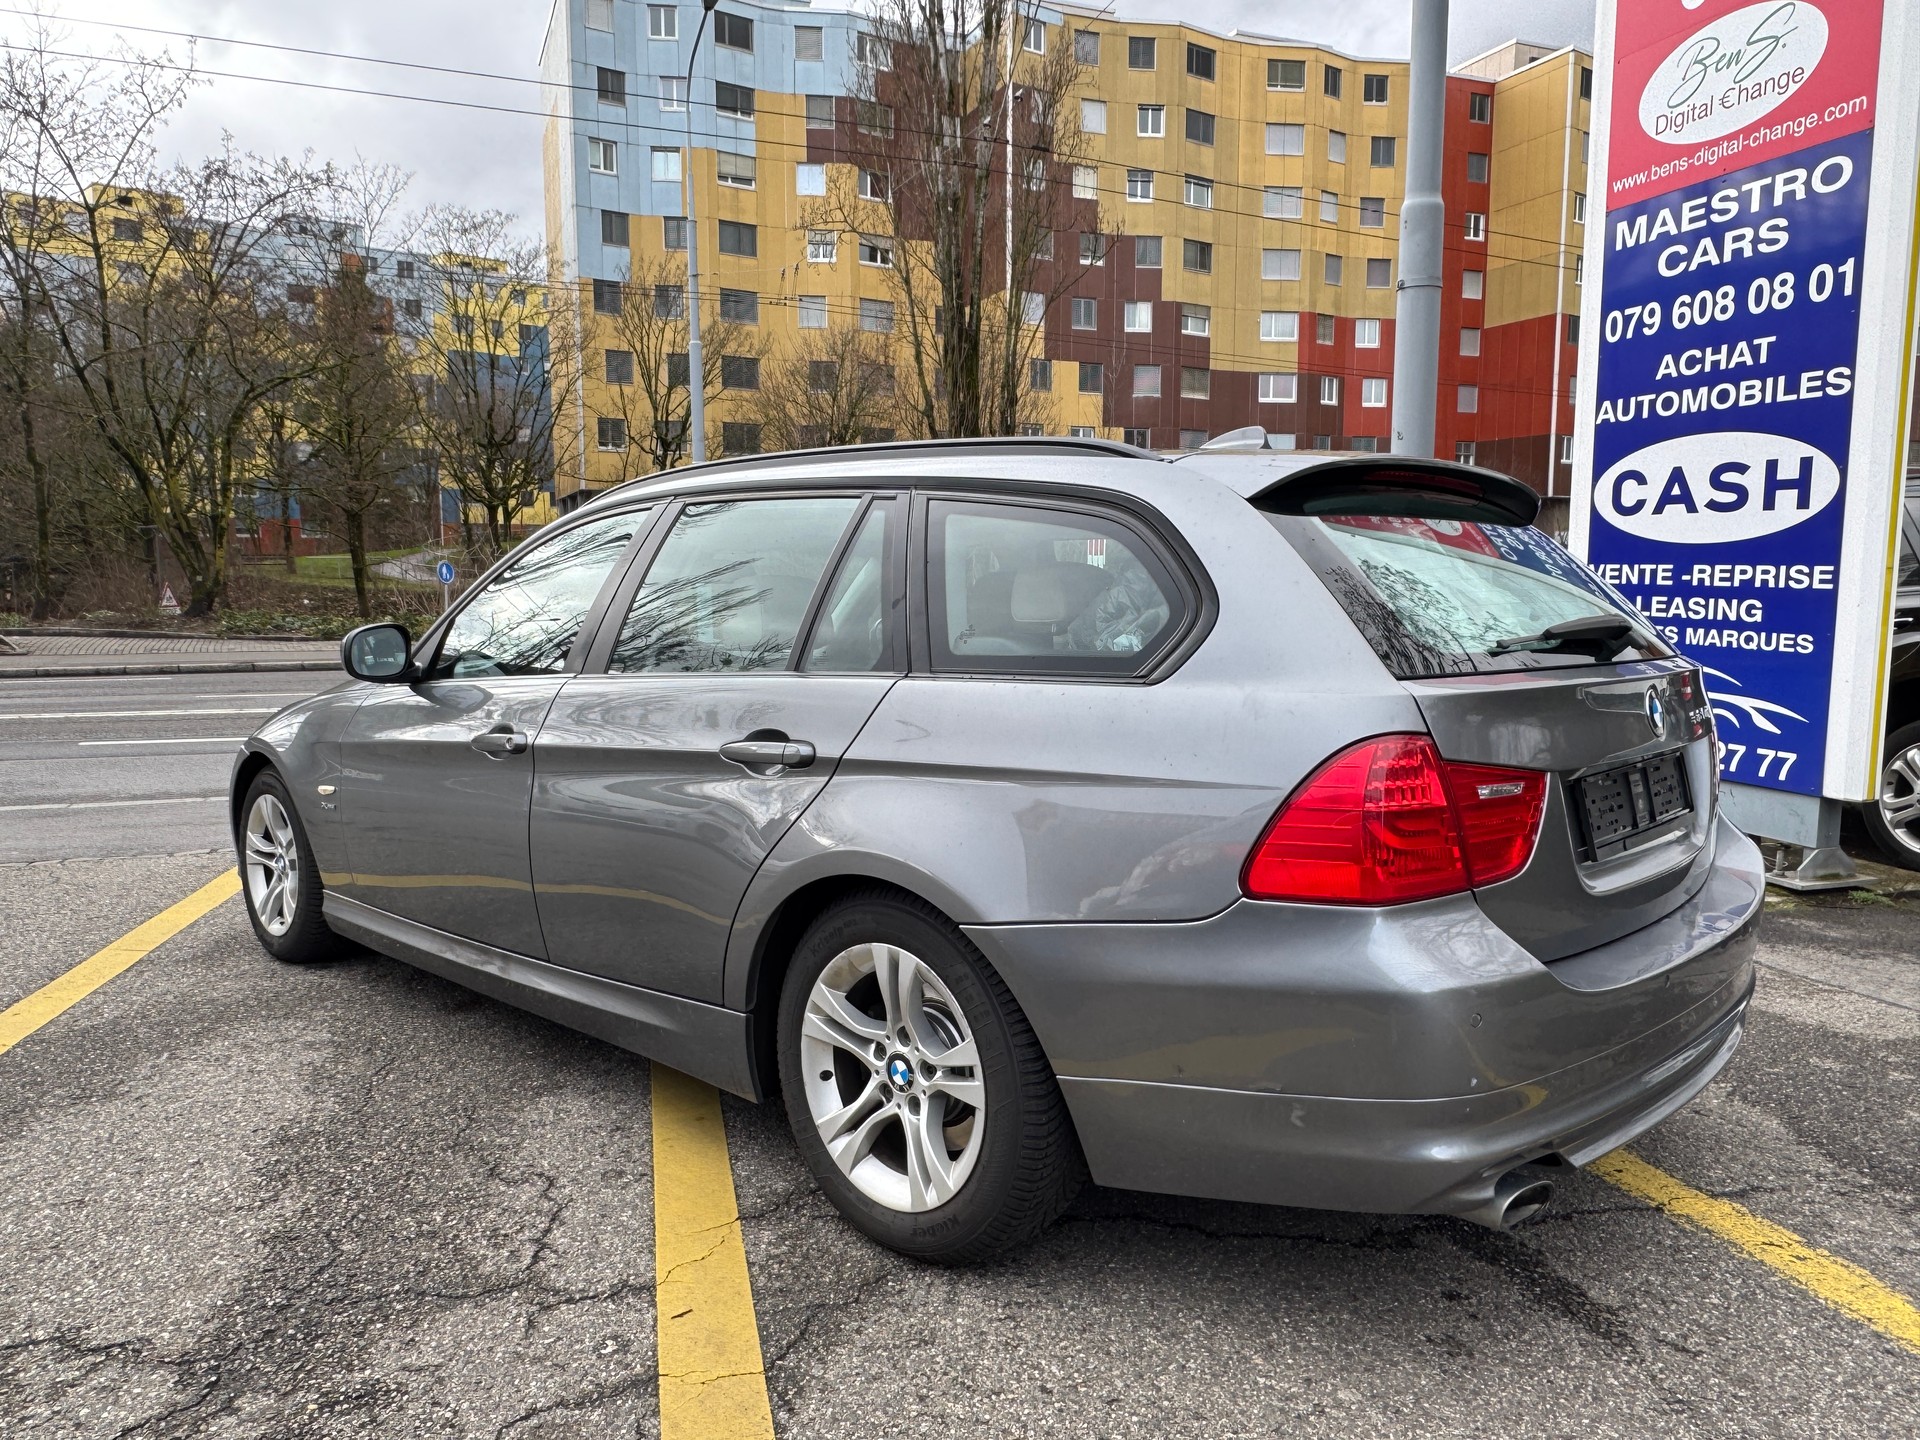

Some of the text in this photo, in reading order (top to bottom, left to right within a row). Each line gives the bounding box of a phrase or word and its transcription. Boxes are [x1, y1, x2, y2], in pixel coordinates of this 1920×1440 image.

[1612, 95, 1868, 194] www.bens-digital-change.com
[1654, 95, 1714, 136] Digital
[1615, 155, 1854, 251] MAESTRO
[1657, 218, 1789, 278] CARS
[1605, 257, 1856, 344] 079 608 08 01
[1655, 335, 1777, 381] ACHAT
[1595, 366, 1852, 425] AUTOMOBILES
[1611, 456, 1815, 517] CASH
[1635, 595, 1763, 623] LEASING
[1685, 628, 1815, 655] MARQUES
[1756, 748, 1798, 781] 77
